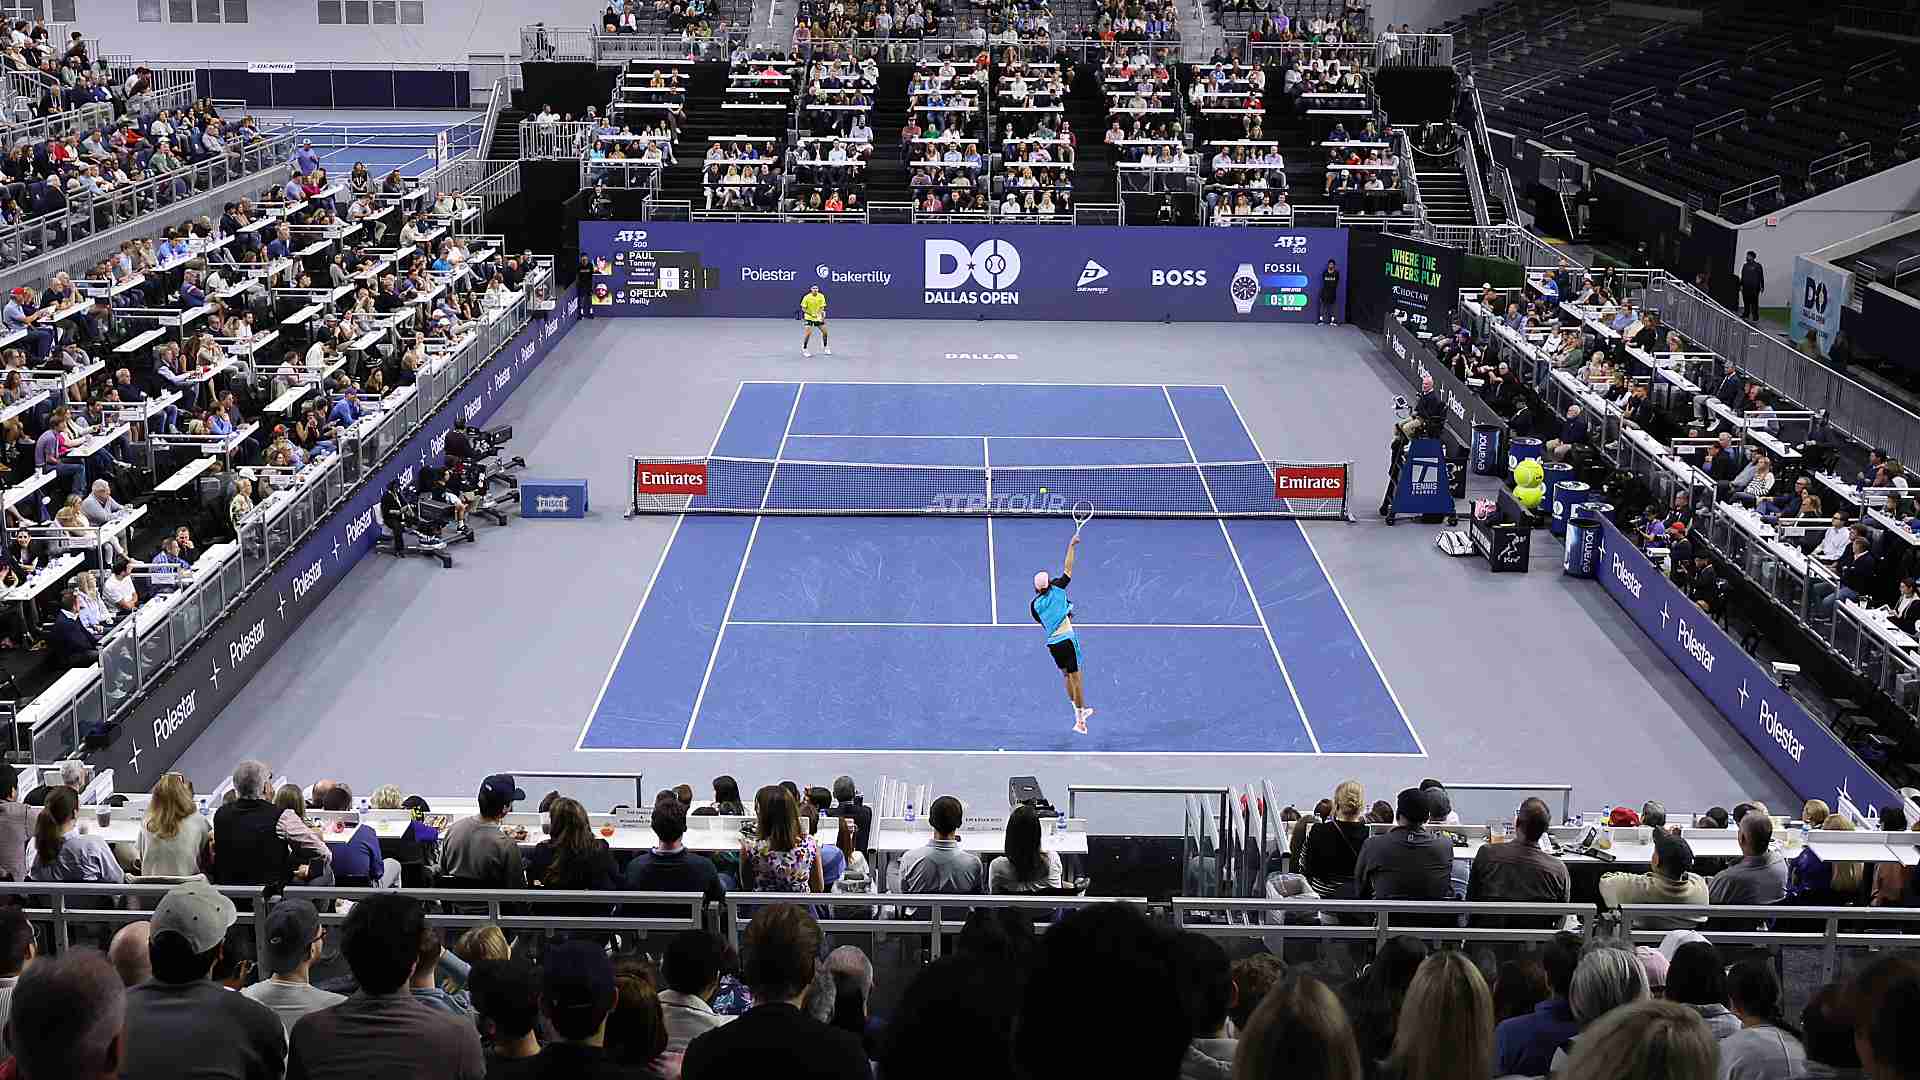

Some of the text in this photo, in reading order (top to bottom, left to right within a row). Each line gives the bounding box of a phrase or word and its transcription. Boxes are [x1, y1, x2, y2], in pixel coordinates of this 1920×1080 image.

[614, 230, 647, 241] ATP
[1274, 236, 1307, 248] ATP
[629, 251, 654, 259] PAUL
[629, 260, 656, 269] Tommy
[1392, 248, 1437, 272] WHERE THE
[683, 270, 689, 278] 2
[741, 267, 797, 281] Polestar
[831, 270, 891, 286] bakertilly
[1151, 269, 1207, 286] BOSS
[1264, 263, 1302, 273] FOSSIL
[1385, 262, 1441, 288] PLAYERS PLAY
[629, 289, 668, 298] OPELKA
[683, 280, 689, 288] 2
[629, 298, 650, 306] Reilly
[925, 291, 1019, 305] DALLAS OPEN
[544, 317, 559, 339] Polestar
[521, 340, 535, 363] Polestar
[494, 365, 511, 391] Polestar
[463, 395, 482, 423] Polestar
[1448, 389, 1466, 420] Polestar
[1476, 431, 1488, 472] evamor
[641, 471, 704, 485] Emirates
[1279, 475, 1341, 489] Emirates
[346, 507, 372, 547] Polestar
[1583, 529, 1594, 573] evamor
[292, 558, 323, 601] Polestar
[1611, 552, 1642, 600] Polestar
[229, 618, 265, 669] Polestar
[1677, 617, 1716, 674] Polestar
[153, 688, 197, 748] Polestar
[1759, 698, 1805, 764] Polestar
